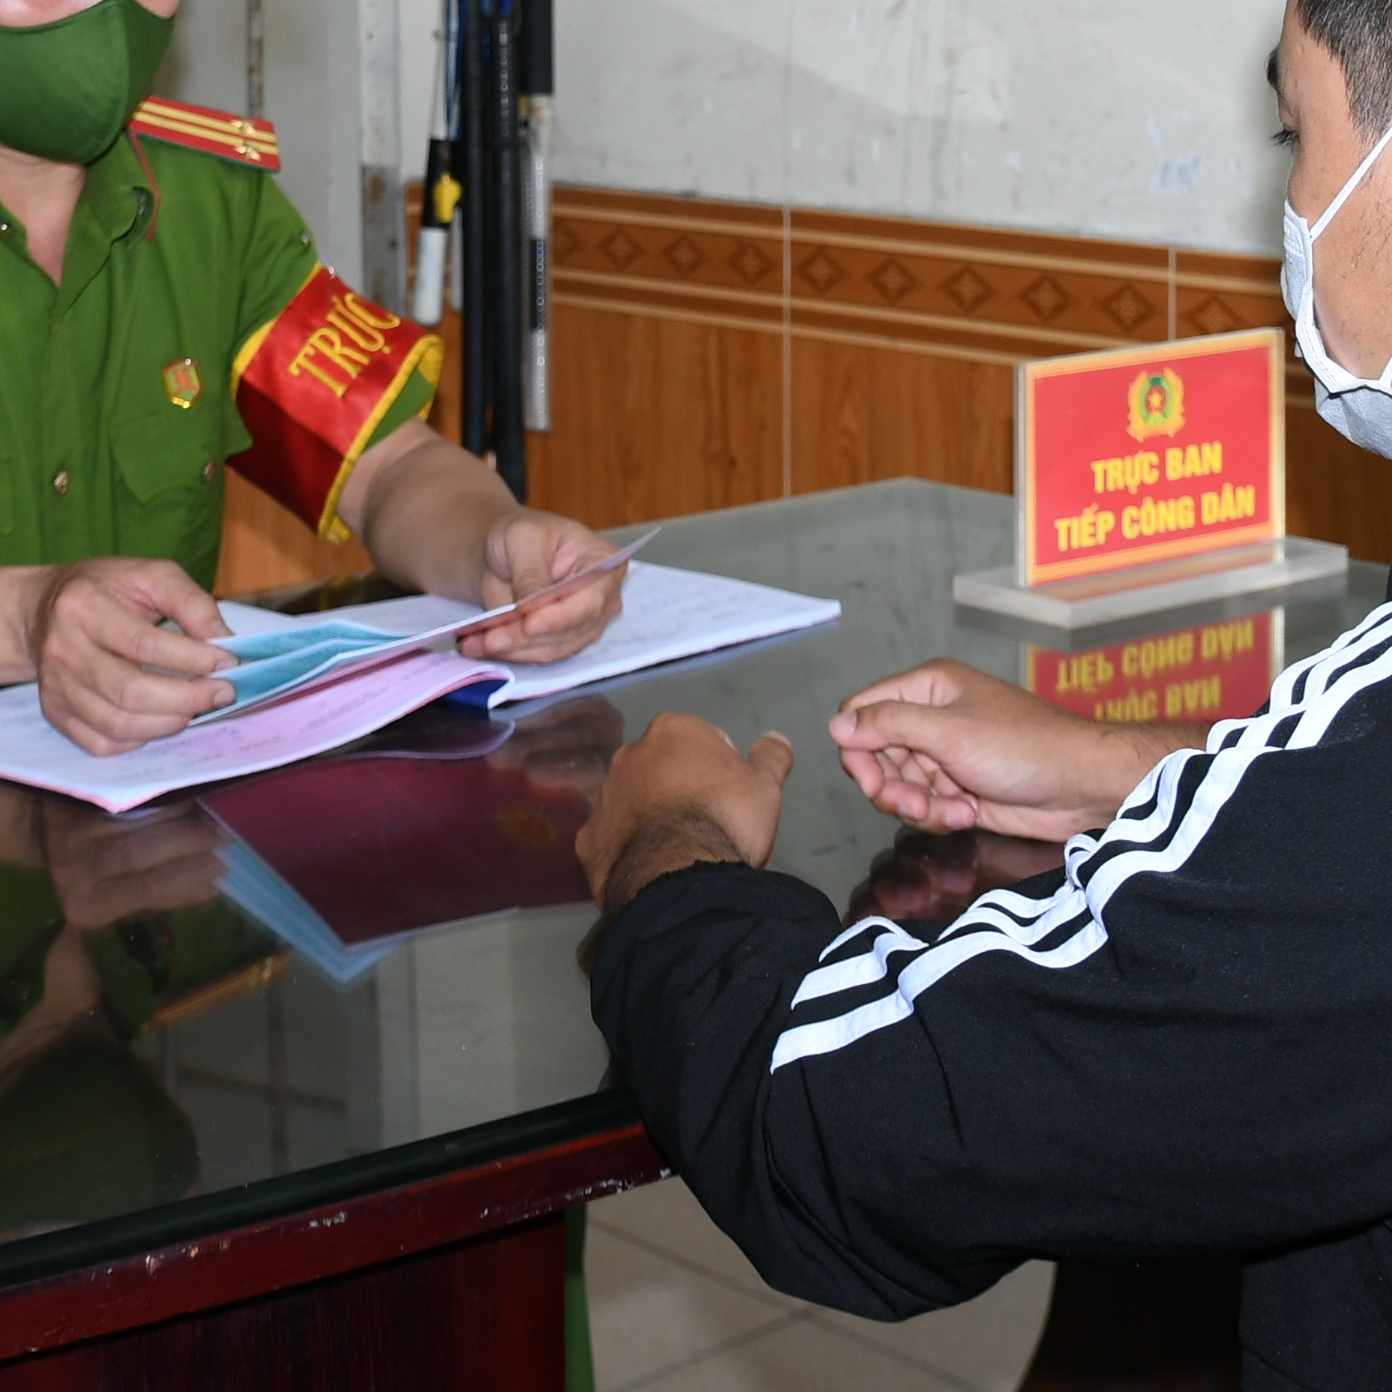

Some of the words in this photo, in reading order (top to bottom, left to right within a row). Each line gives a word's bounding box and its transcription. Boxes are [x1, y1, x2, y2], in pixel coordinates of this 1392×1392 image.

[288, 293, 400, 398] TRỰC
[1091, 450, 1159, 494] TRỰC
[1165, 441, 1222, 480] BAN
[1054, 503, 1115, 551] TIẾP
[1122, 496, 1195, 539] CÔNG
[1201, 482, 1255, 525] DÂN
